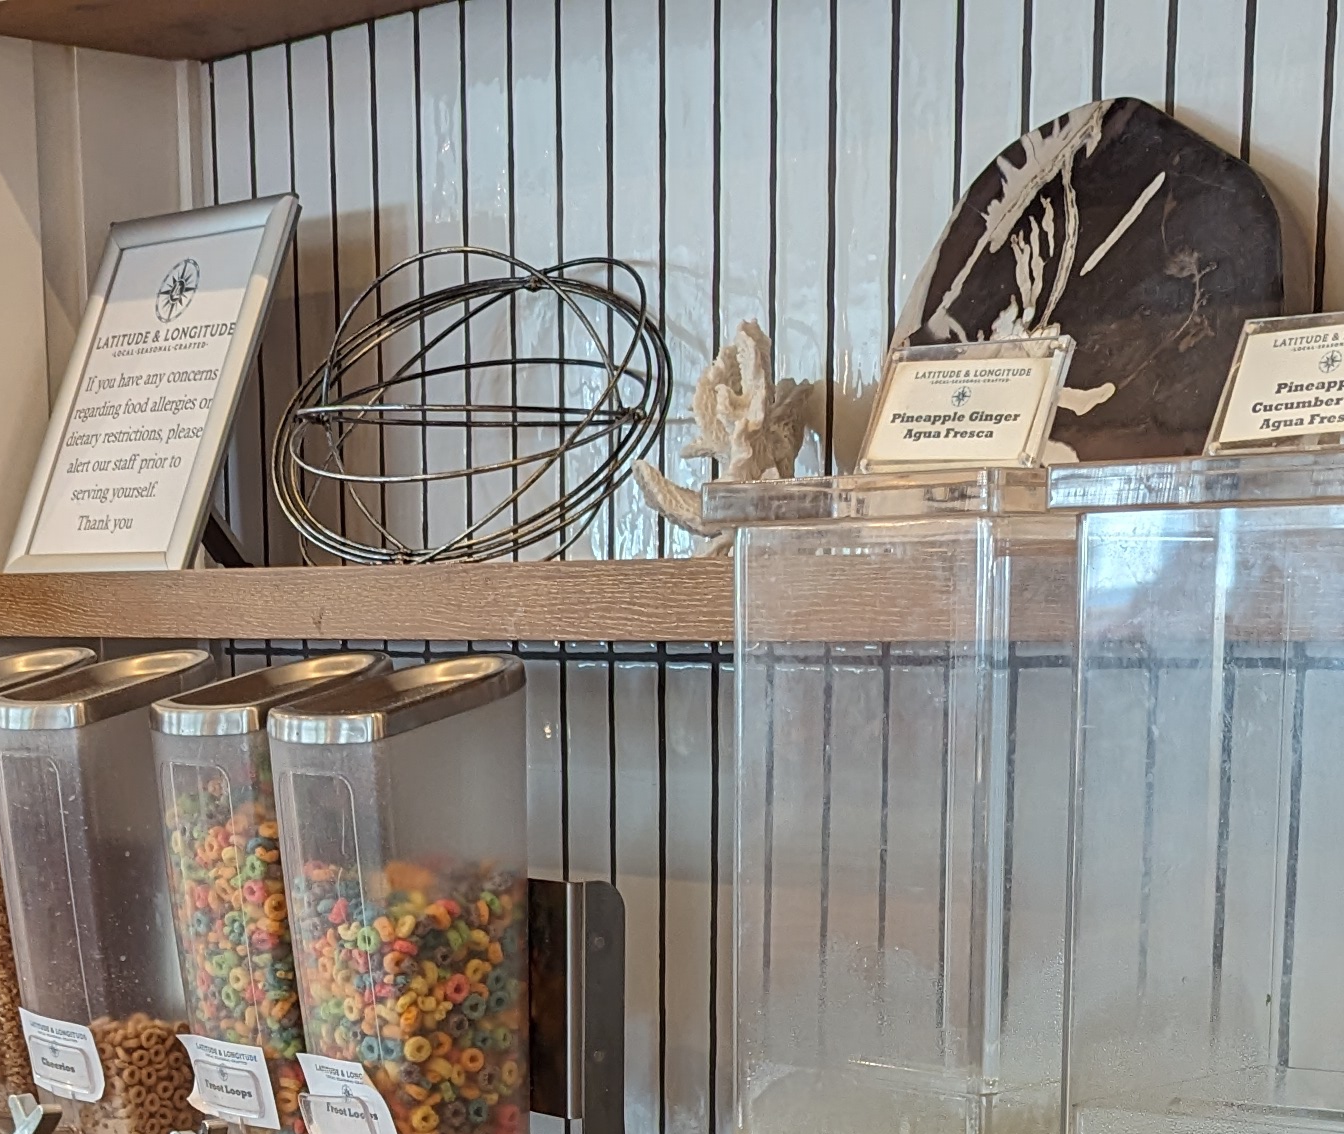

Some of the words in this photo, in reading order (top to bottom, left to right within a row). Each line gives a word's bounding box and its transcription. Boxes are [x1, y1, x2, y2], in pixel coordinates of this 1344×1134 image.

[96, 331, 151, 350] LATITUDE
[152, 330, 160, 343] &
[163, 322, 236, 342] LONGITUDE
[1273, 333, 1329, 348] LATITUDE
[1331, 332, 1340, 341] &
[85, 375, 97, 392] If
[95, 378, 115, 394] you
[117, 373, 141, 388] have
[144, 371, 166, 388] any
[167, 368, 219, 383] concerns
[914, 370, 961, 380] LATITUDE
[963, 369, 970, 378] &
[973, 368, 1032, 378] LONGITUDE
[74, 401, 122, 422] regarding
[123, 398, 151, 415] food
[150, 394, 198, 416] allergies
[1251, 393, 1344, 414] Cucumber
[890, 412, 966, 425] Pineapple
[968, 411, 1021, 424] Ginger
[1259, 417, 1304, 432] Agua
[66, 431, 100, 449] dietary
[102, 425, 163, 444] restrictions,
[165, 423, 204, 444] please
[903, 428, 941, 441] Agua
[943, 428, 994, 439] Fresca
[66, 457, 91, 474] alert
[92, 460, 111, 473] our
[112, 453, 139, 471] staff
[137, 452, 168, 474] prior
[169, 455, 182, 469] to
[70, 484, 109, 504] serving
[109, 481, 158, 503] yourself.
[77, 514, 110, 531] Thank
[110, 517, 133, 534] you
[41, 1056, 75, 1073] Cheerios
[225, 1084, 253, 1099] Loops
